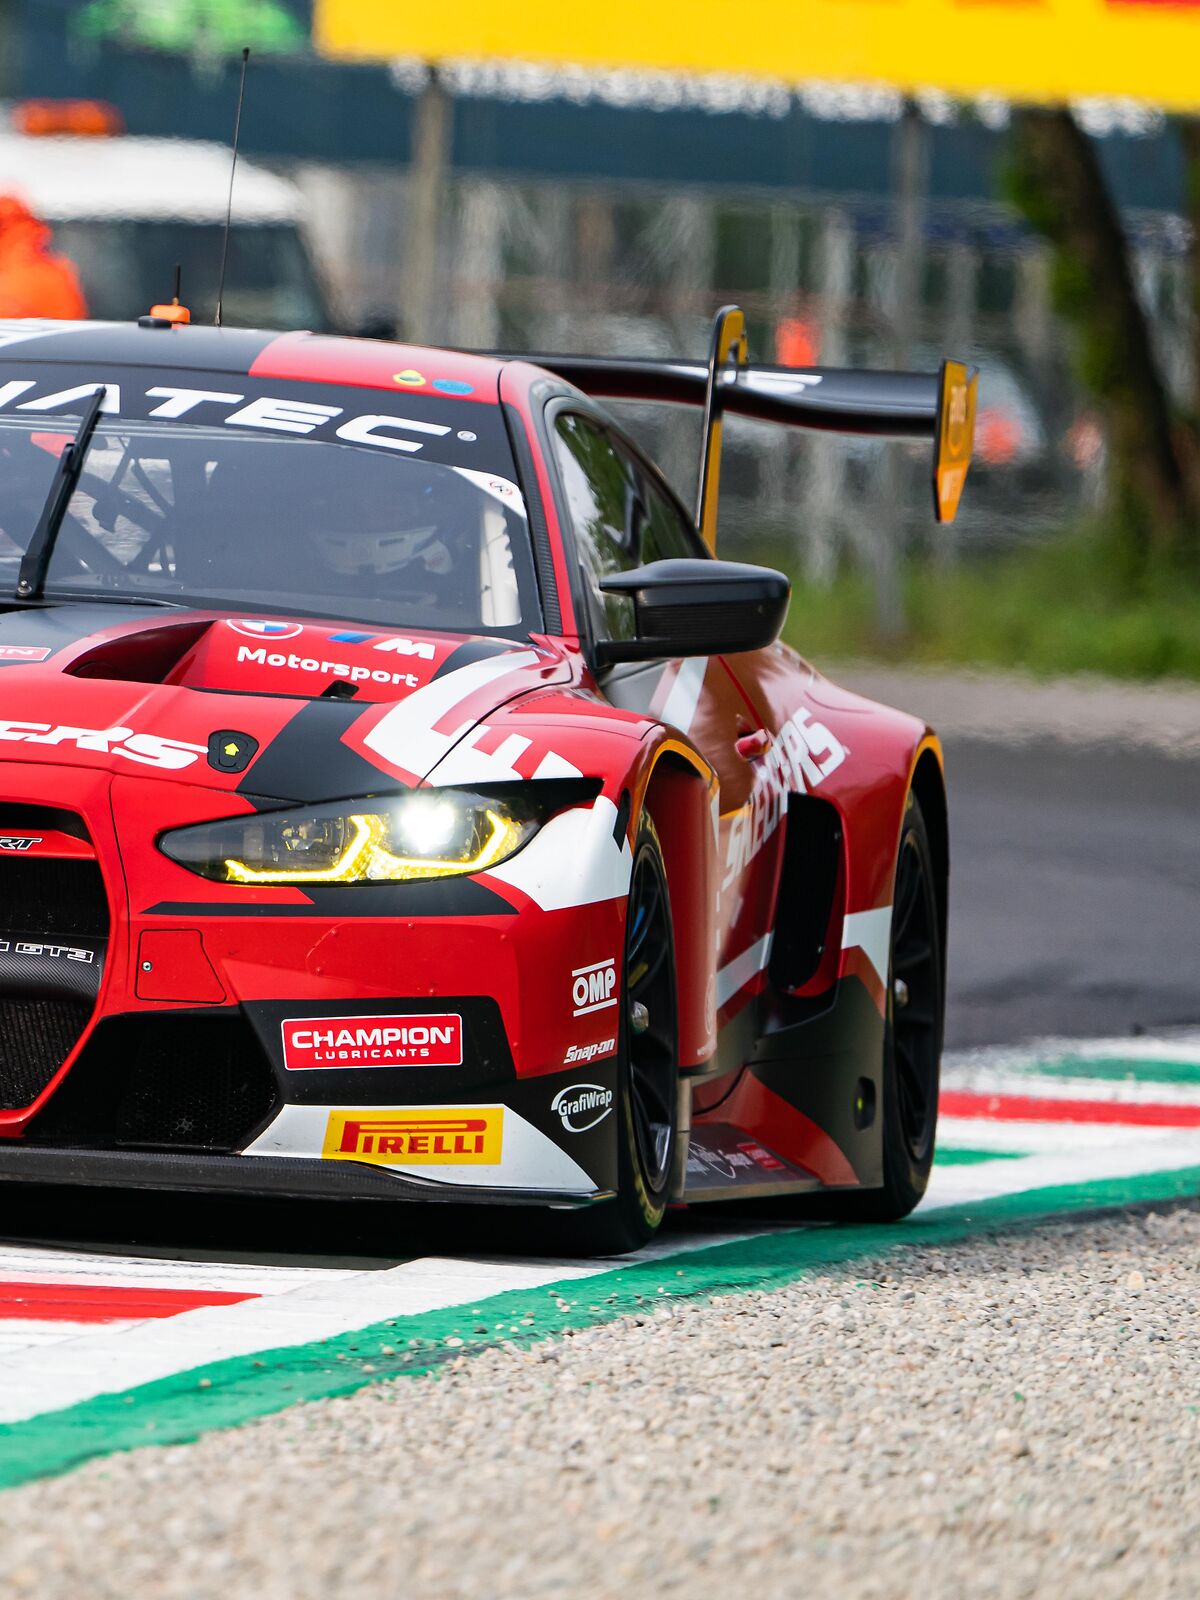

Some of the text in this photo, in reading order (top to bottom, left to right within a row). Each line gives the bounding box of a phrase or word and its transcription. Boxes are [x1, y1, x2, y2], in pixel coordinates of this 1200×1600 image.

[237, 646, 419, 687] Motorsport
[15, 942, 94, 963] GT3
[572, 966, 617, 1006] OMP
[291, 1026, 452, 1049] CHAMPION
[563, 1038, 615, 1064] Snap-on
[314, 1047, 430, 1060] LUBRICANTS
[558, 1086, 613, 1117] GrafiWrap
[339, 1119, 488, 1155] PIRELLI
